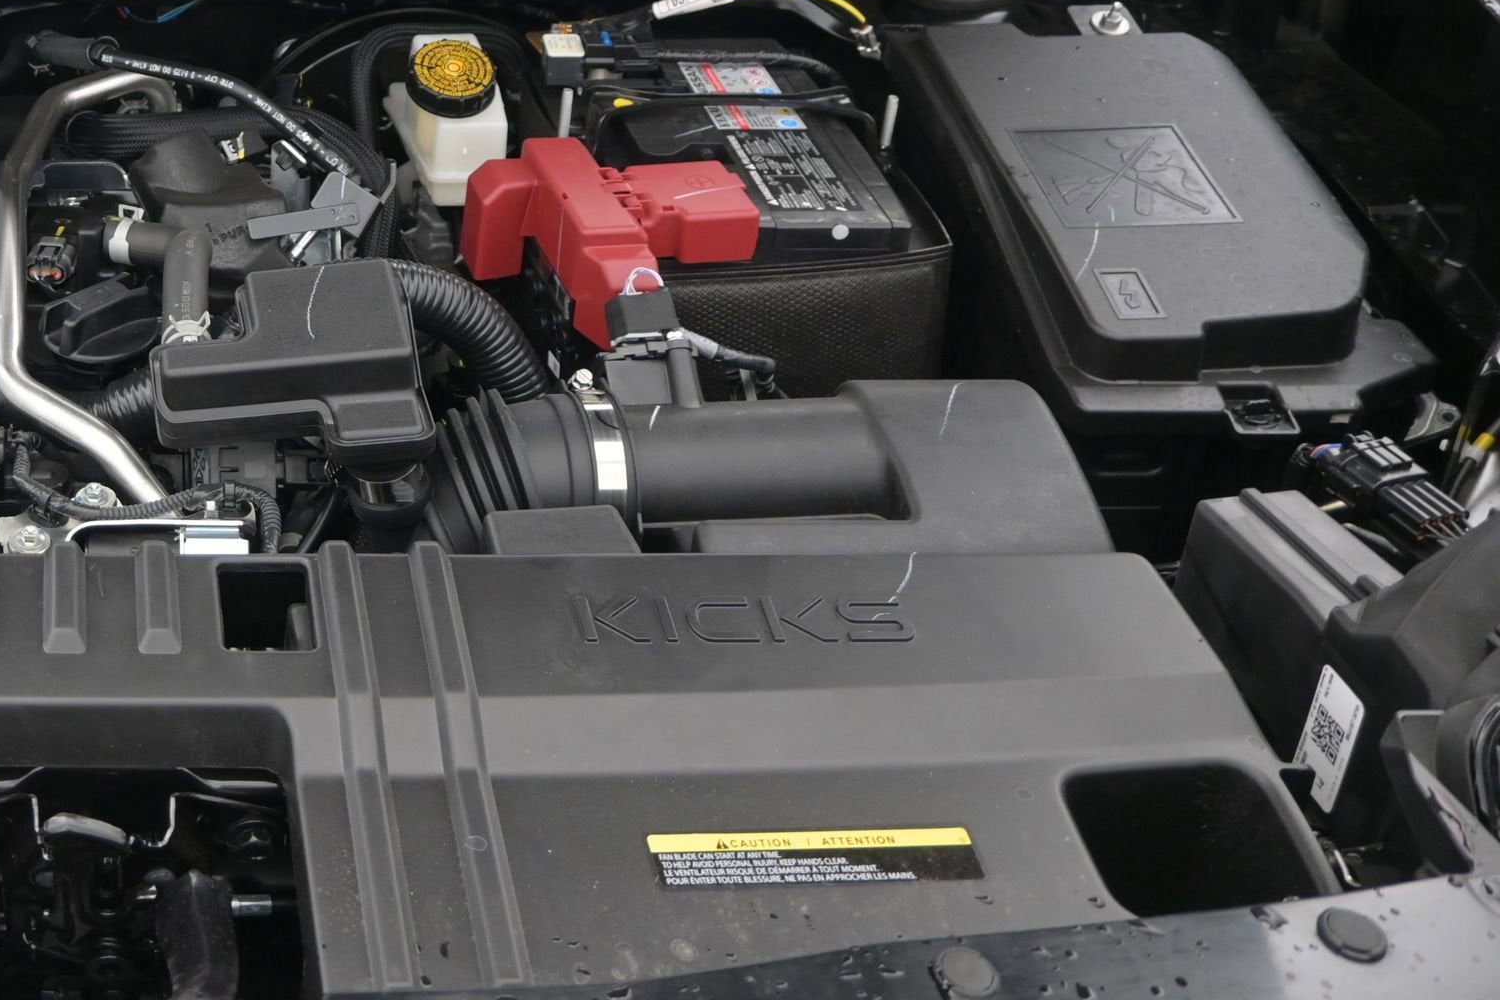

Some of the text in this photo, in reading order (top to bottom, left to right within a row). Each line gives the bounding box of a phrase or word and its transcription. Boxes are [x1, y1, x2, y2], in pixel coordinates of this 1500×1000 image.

[149, 63, 160, 73] NOT
[272, 111, 286, 124] NOT
[573, 596, 915, 643] KICKS
[730, 838, 791, 848] CAUTION
[822, 836, 896, 846] ATTENTION
[780, 858, 796, 866] KEEP
[798, 858, 823, 866] HANDS
[674, 868, 726, 876] VENTILATEUR
[726, 867, 754, 876] RISQUE
[756, 867, 767, 875] DE
[818, 865, 840, 873] TOUT
[666, 877, 689, 885] POUR
[717, 876, 743, 884] TOUTE
[797, 874, 812, 882] PAS
[825, 873, 873, 881] APPROCHER
[874, 872, 887, 880] LES
